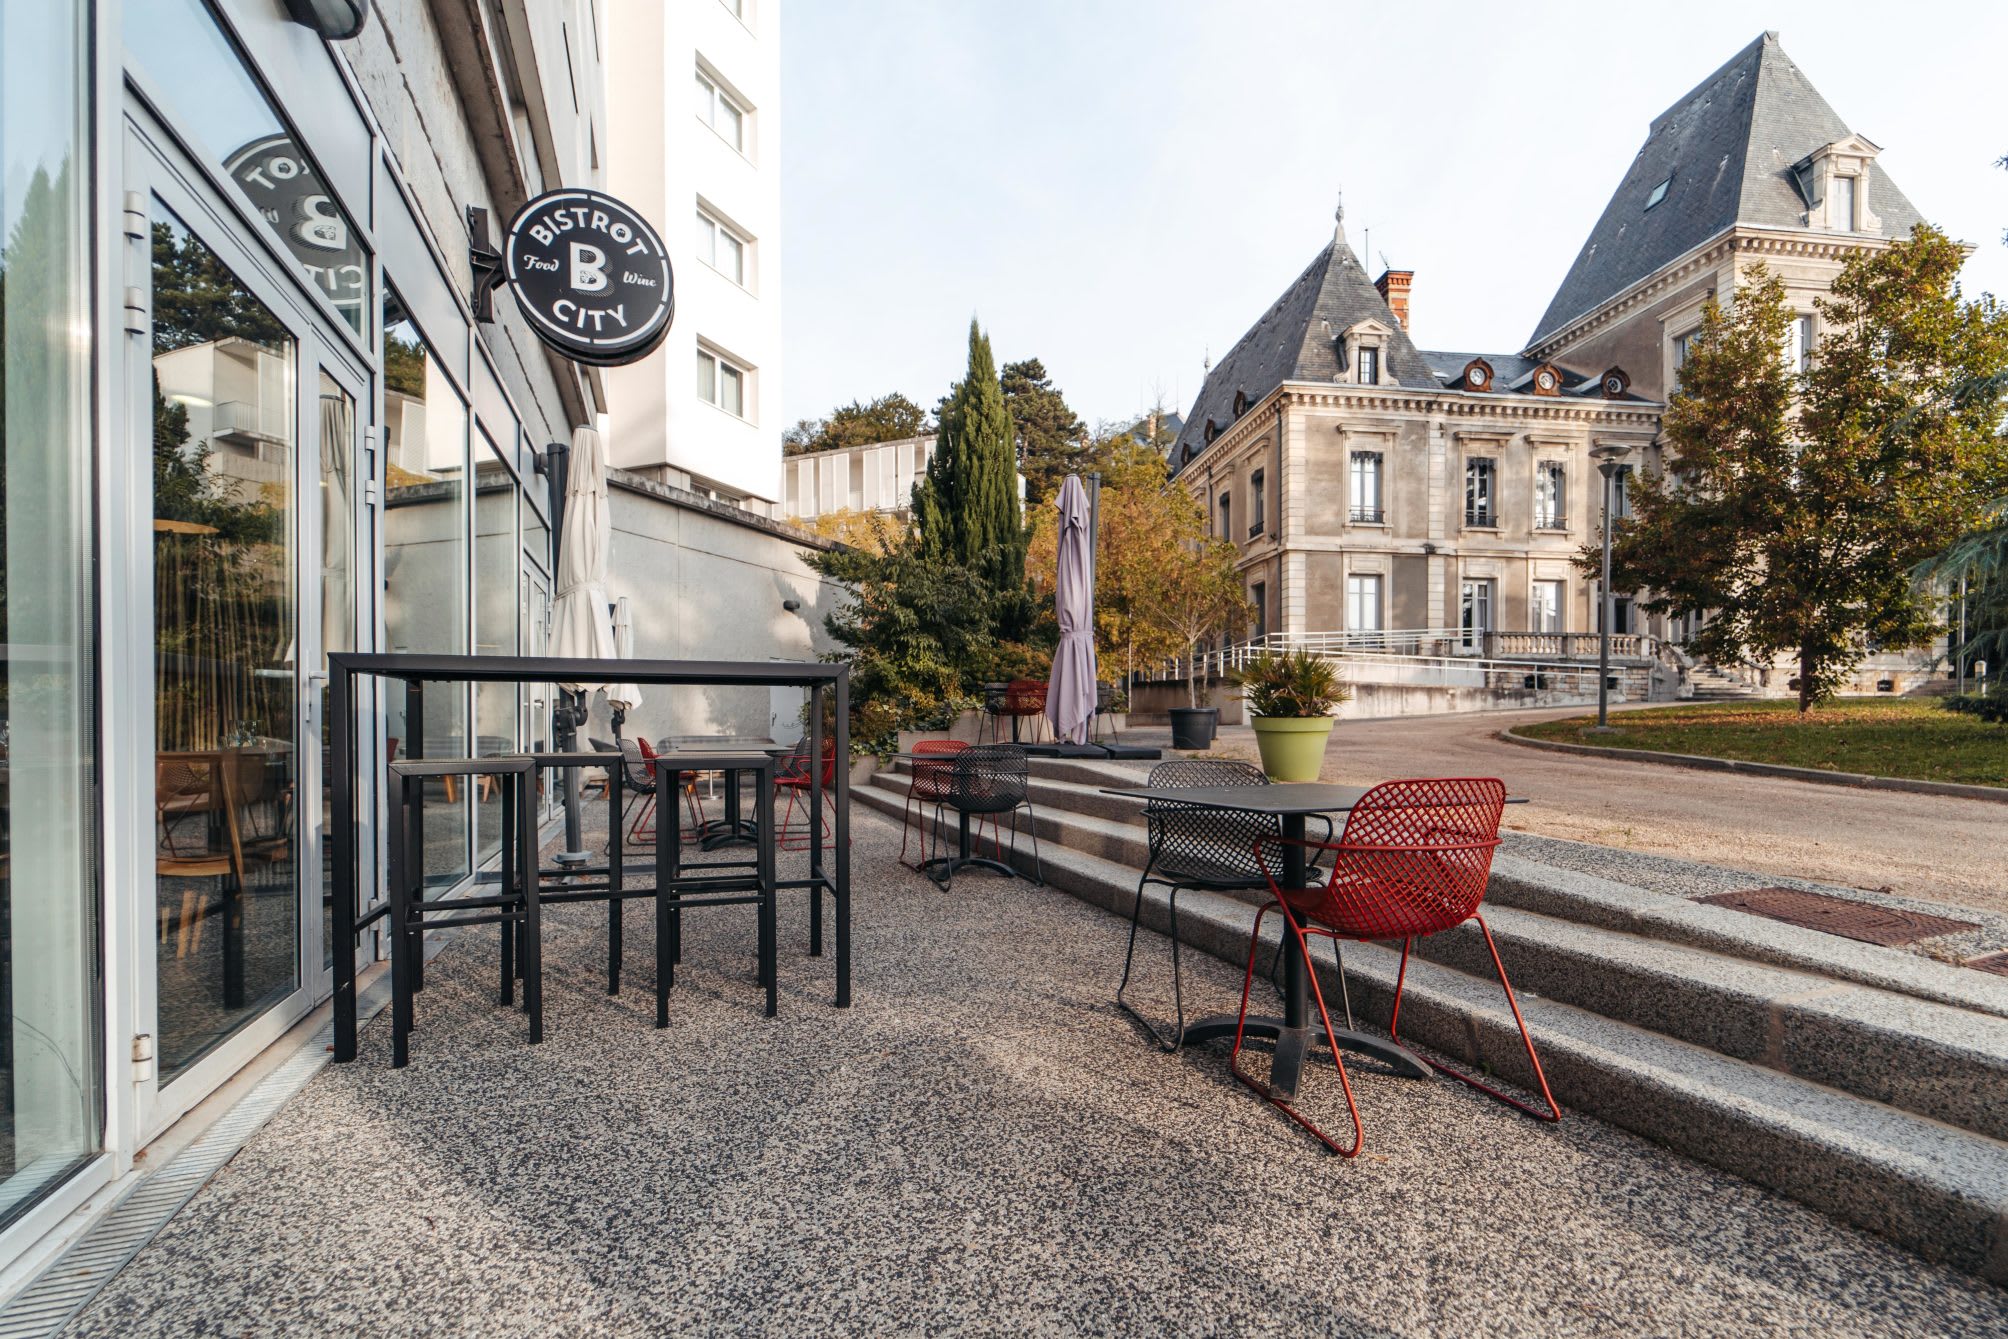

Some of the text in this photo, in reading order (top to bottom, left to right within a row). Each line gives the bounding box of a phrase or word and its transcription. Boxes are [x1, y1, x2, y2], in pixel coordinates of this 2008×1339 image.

[529, 207, 648, 256] BISTROT
[523, 241, 657, 292] Food B Wine
[552, 299, 628, 331] CITY
